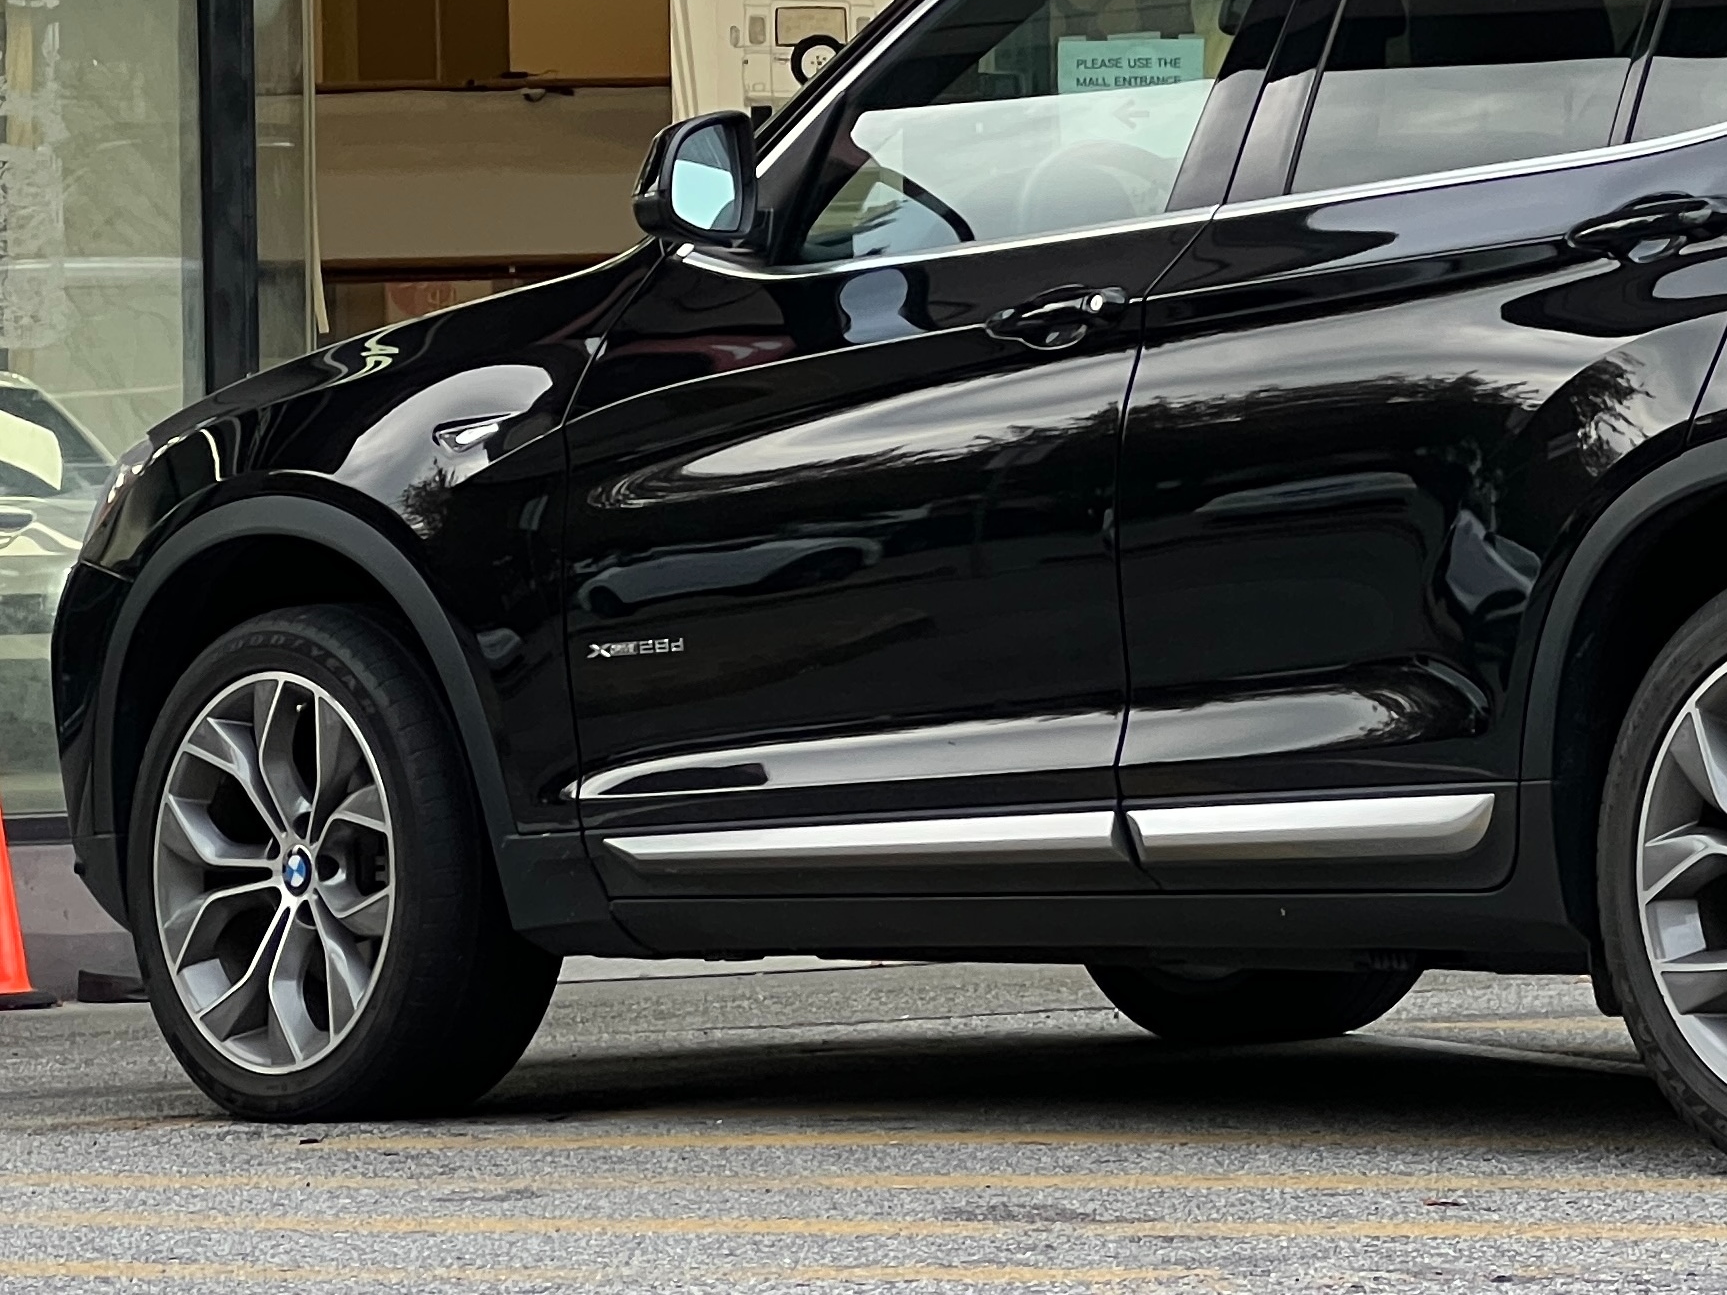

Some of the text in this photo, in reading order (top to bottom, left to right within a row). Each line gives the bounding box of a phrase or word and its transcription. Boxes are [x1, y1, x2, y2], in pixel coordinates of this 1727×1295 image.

[1075, 56, 1182, 70] PLEASE USE THE
[1075, 75, 1111, 88] MALL
